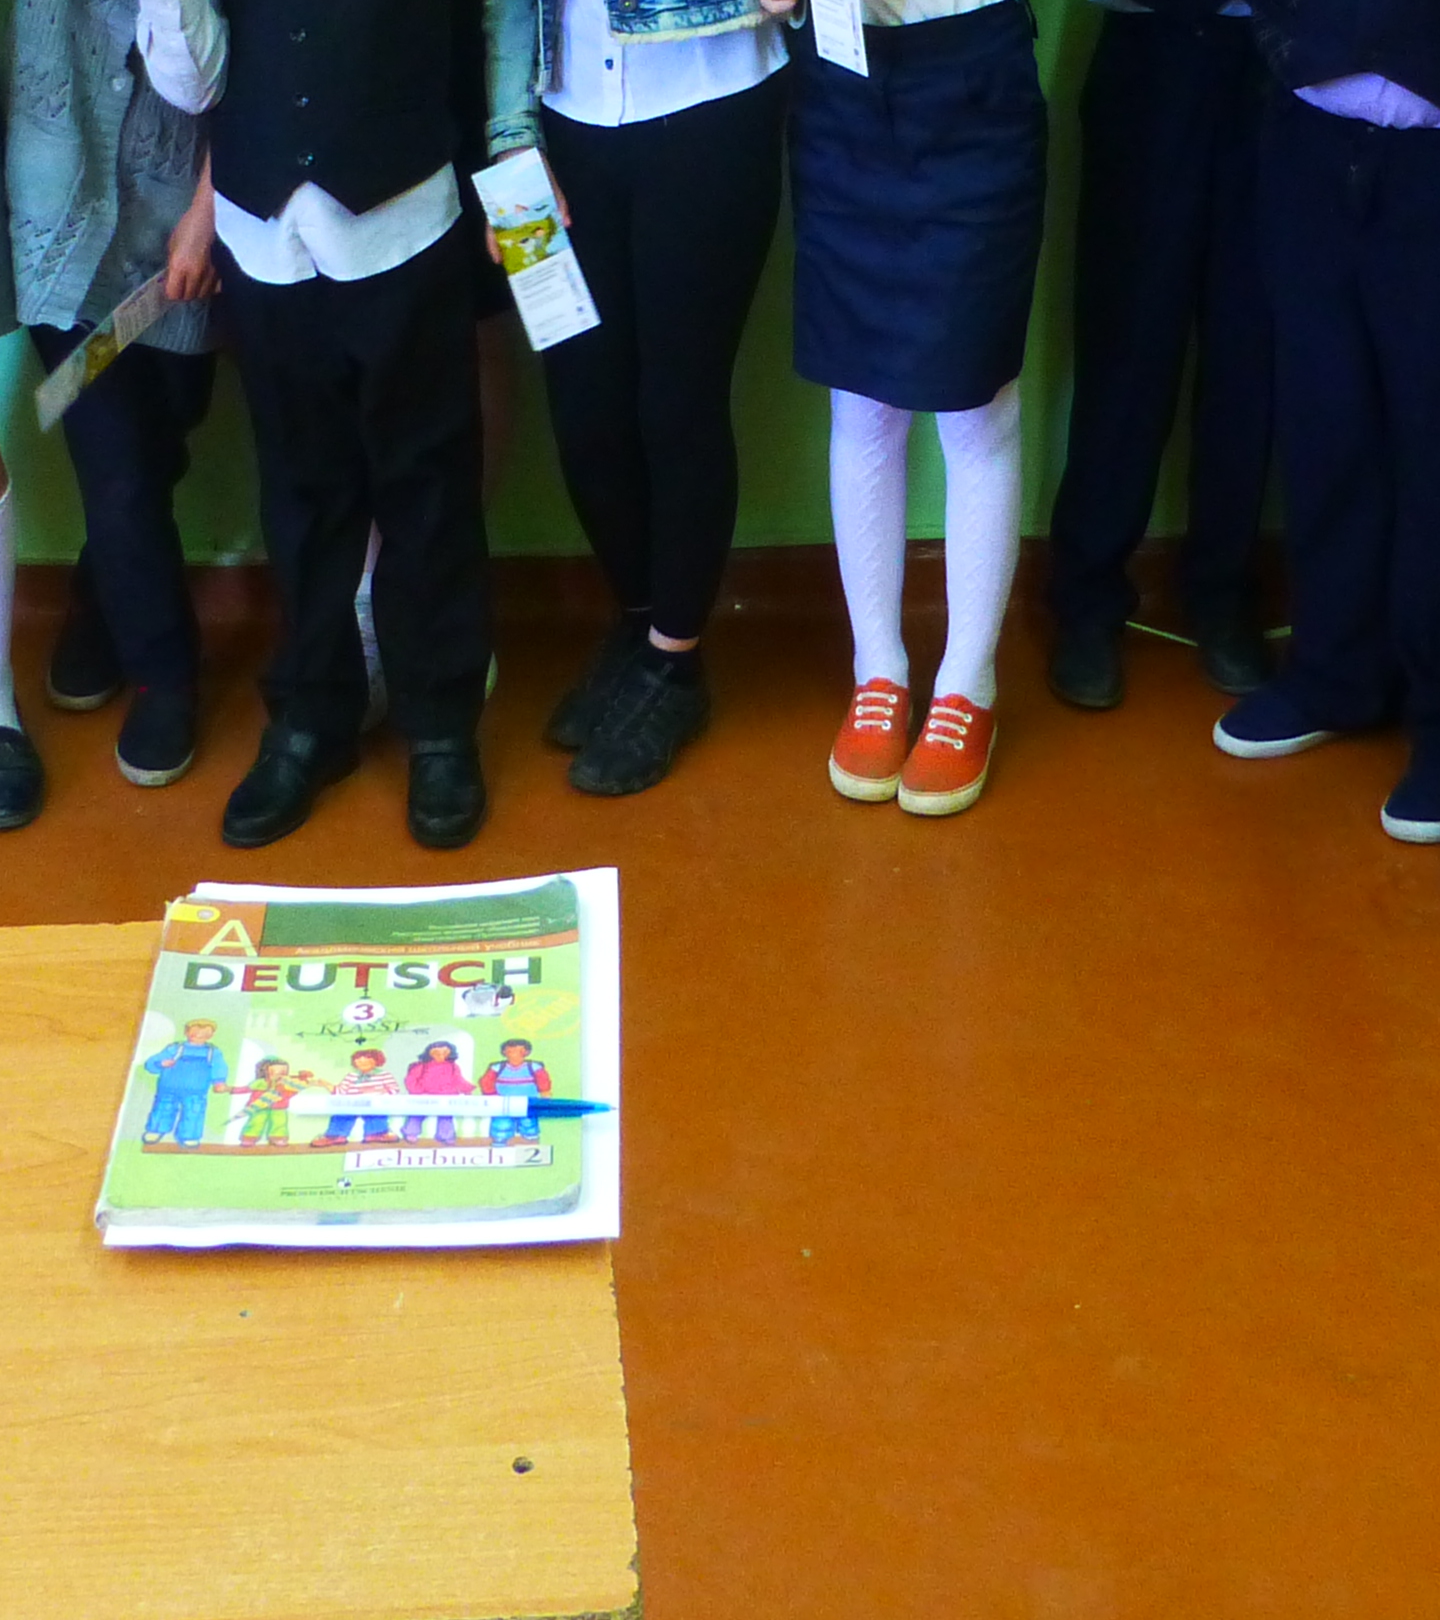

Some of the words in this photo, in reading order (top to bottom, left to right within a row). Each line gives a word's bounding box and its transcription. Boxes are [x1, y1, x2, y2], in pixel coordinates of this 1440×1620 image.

[198, 920, 258, 957] A
[183, 956, 544, 993] DEUTSCH
[352, 1002, 375, 1021] 3
[355, 1147, 505, 1170] Lehrbuch
[524, 1147, 544, 1164] 2
